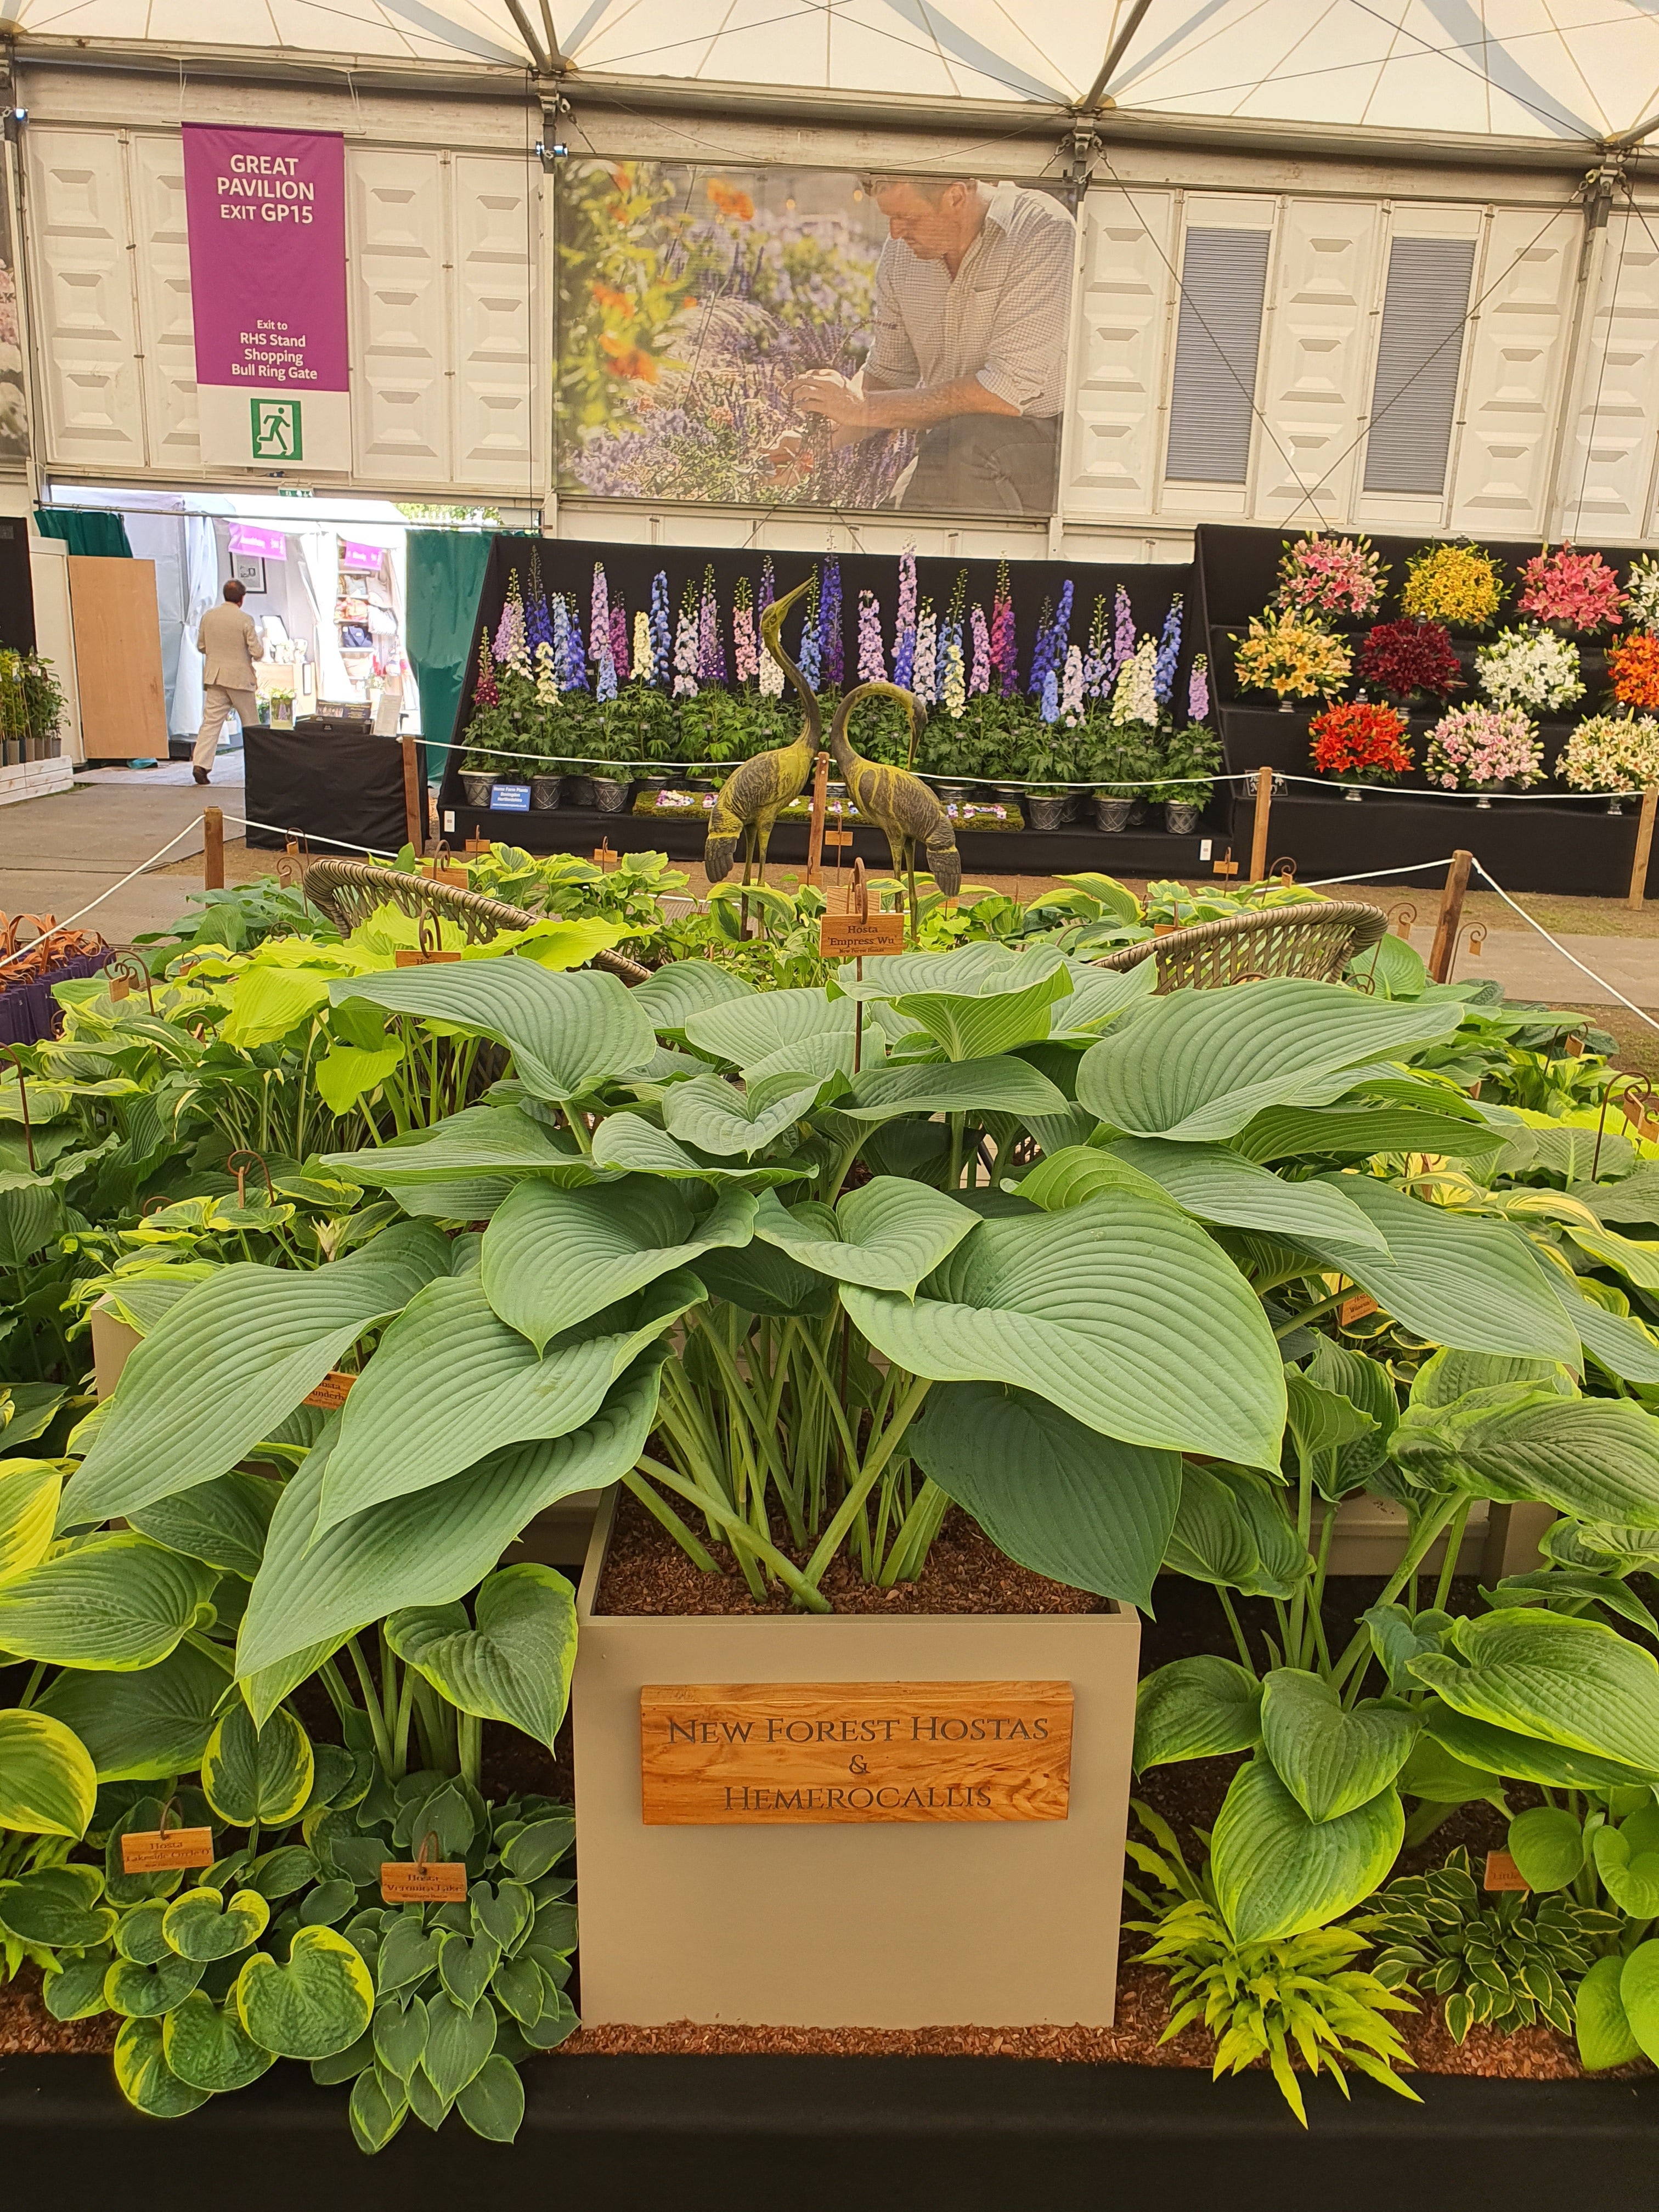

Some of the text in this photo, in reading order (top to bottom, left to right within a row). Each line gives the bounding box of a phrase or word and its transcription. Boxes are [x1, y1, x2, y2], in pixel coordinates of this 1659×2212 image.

[230, 154, 298, 176] GREAT
[217, 177, 315, 201] PAVILION
[221, 203, 314, 224] EXIT GP15
[257, 319, 288, 331] Exit to
[240, 332, 306, 348] RHS Stand
[244, 348, 303, 367] Shopping
[232, 364, 318, 381] Bull Ring Gate
[848, 926, 878, 934] Hosta
[319, 1382, 341, 1390] osta
[669, 1716, 1048, 1744] NEW FOREST HOSTAS
[849, 1754, 870, 1775] &
[724, 1786, 991, 1811] HEMEROCALLIS
[150, 1842, 183, 1850] Hosta
